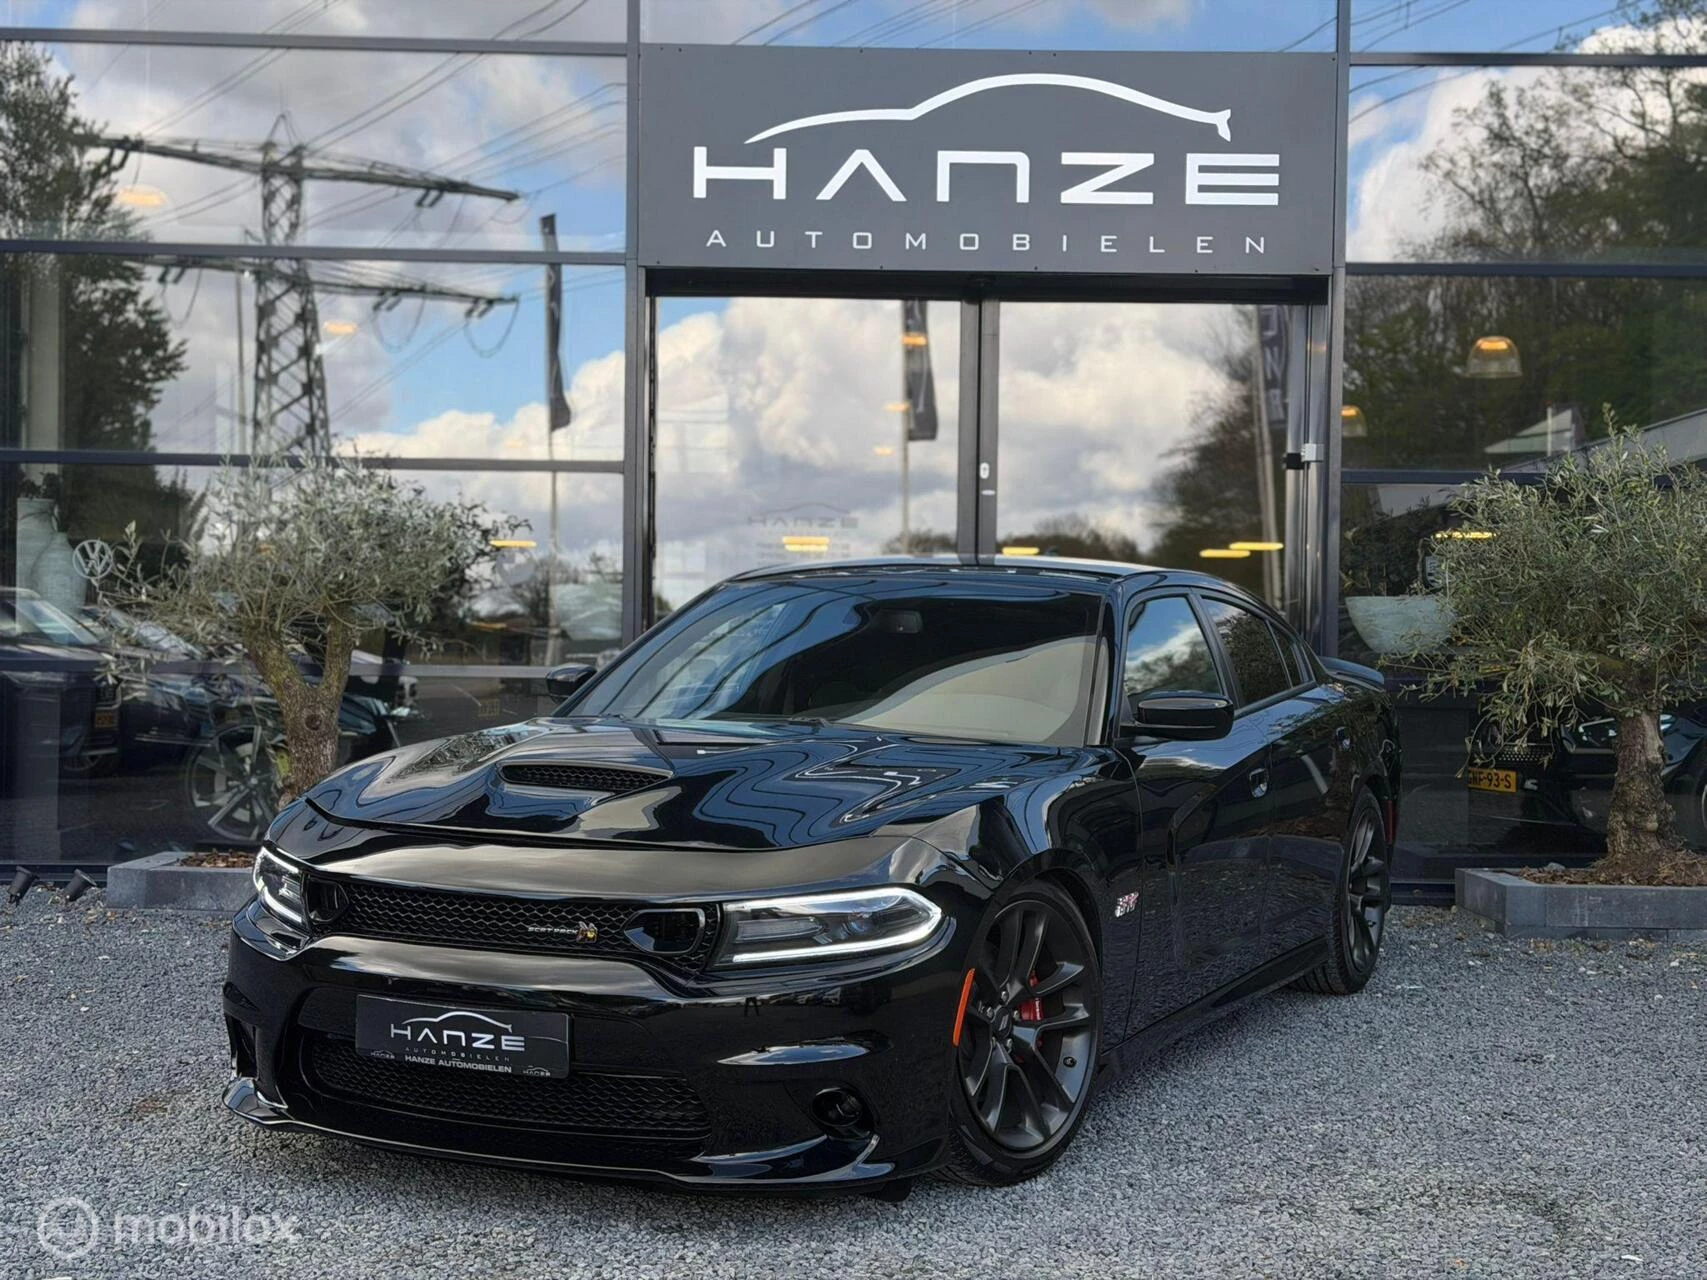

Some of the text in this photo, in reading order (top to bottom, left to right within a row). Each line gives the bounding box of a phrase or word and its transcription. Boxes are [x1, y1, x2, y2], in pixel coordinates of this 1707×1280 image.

[693, 146, 1280, 205] HANZE
[706, 229, 1265, 254] AUTOMOBIELEN
[390, 1023, 525, 1051] HANZE
[405, 1046, 510, 1062] AUTOMOBIELEN
[405, 1055, 512, 1073] HANZE AUTOMOBIELEN
